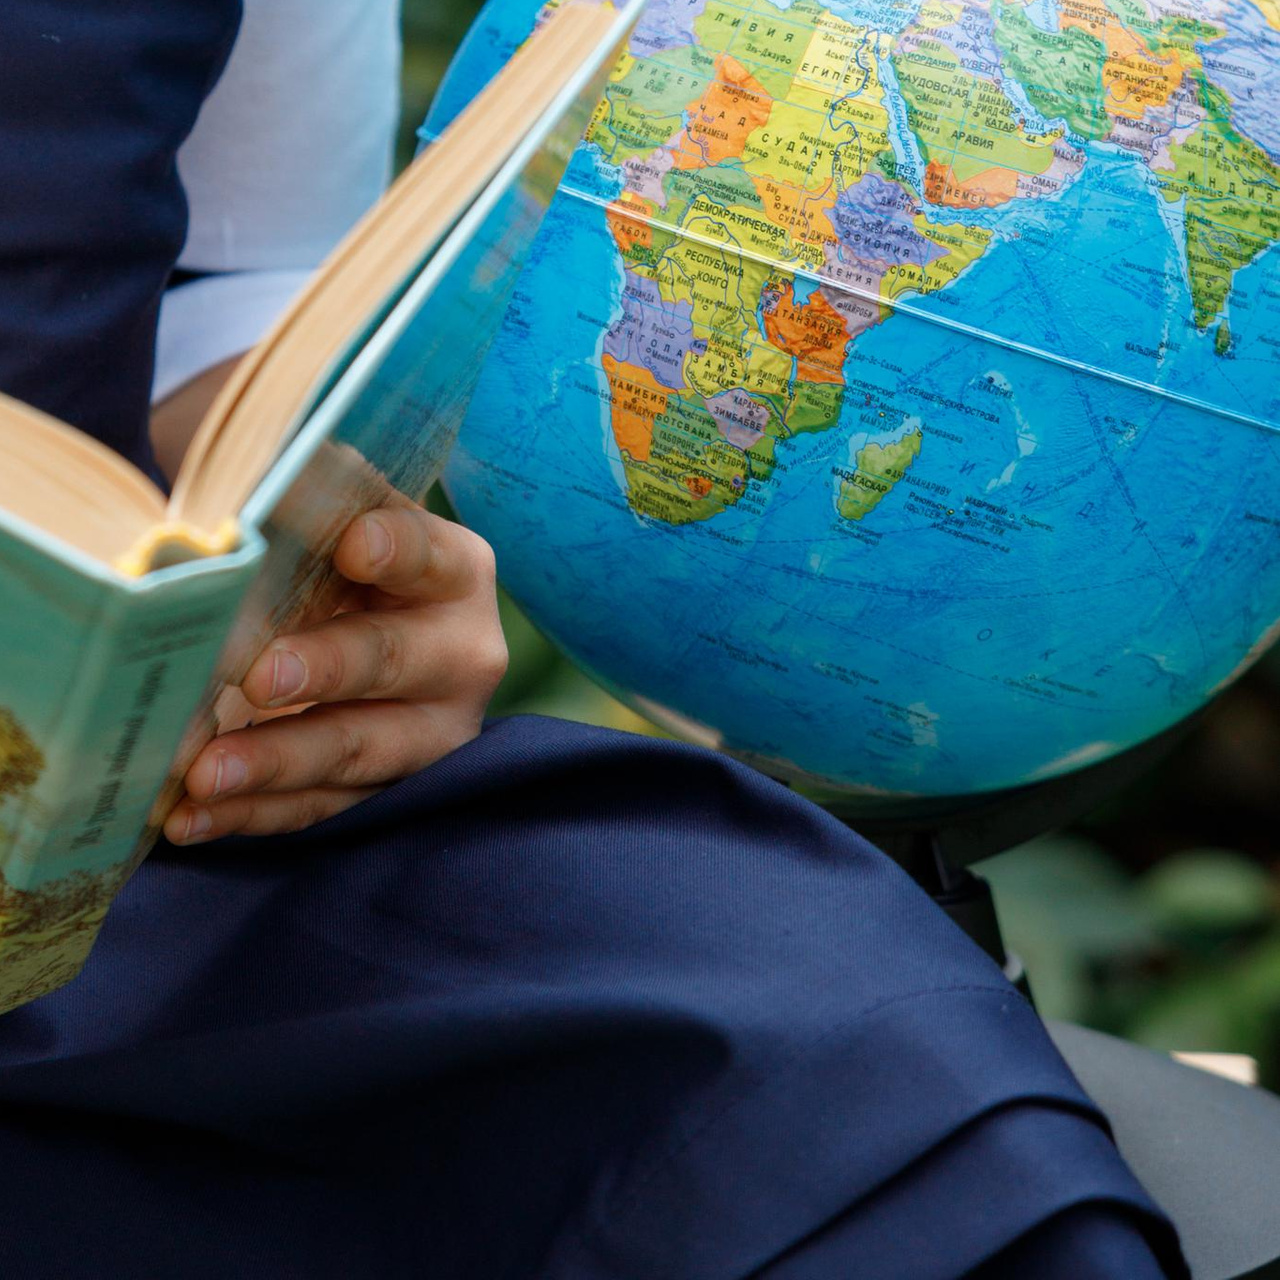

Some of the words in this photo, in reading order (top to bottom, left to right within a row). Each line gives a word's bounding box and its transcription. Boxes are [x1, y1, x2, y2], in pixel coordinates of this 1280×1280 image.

[715, 13, 794, 42] ЛИВИЯ
[920, 9, 953, 22] СИРИЯ
[907, 52, 956, 70] ИОРДАНИЯ
[1011, 43, 1091, 72] ИРАН
[637, 64, 698, 88] НИГЕР
[802, 64, 862, 85] ЕГИПЕТ
[1106, 68, 1168, 92] АФГАНИСТАН
[700, 104, 746, 126] ЧАД
[898, 72, 970, 99] САУДОВСКАЯ
[951, 130, 994, 150] АРАВИЯ
[985, 118, 1016, 131] КАТАР
[761, 134, 822, 159] СУДАН
[1032, 176, 1058, 190] ОМАН
[1188, 171, 1273, 203] ИНДИЯ
[614, 222, 648, 240] ГАБОН
[692, 199, 785, 239] ДЕМОКРАТИЧЕСКАЯ
[844, 230, 910, 259] ЭФИОПИЯ
[684, 248, 744, 278] РЕСПУБЛИКА
[827, 266, 873, 285] КЕНИЯ
[696, 269, 728, 290] КОНГО
[890, 266, 941, 287] СОМАЛИ
[782, 308, 842, 336] ТАНЗАНИЯ
[614, 327, 683, 356] АНГОЛА
[694, 355, 763, 387] ЗАМБИЯ
[610, 379, 665, 404] НАМИБИЯ
[656, 413, 711, 440] БОТСВАНА
[714, 406, 762, 430] ЗИМБАБВЕ
[831, 466, 888, 493] МАДАГАСКАР
